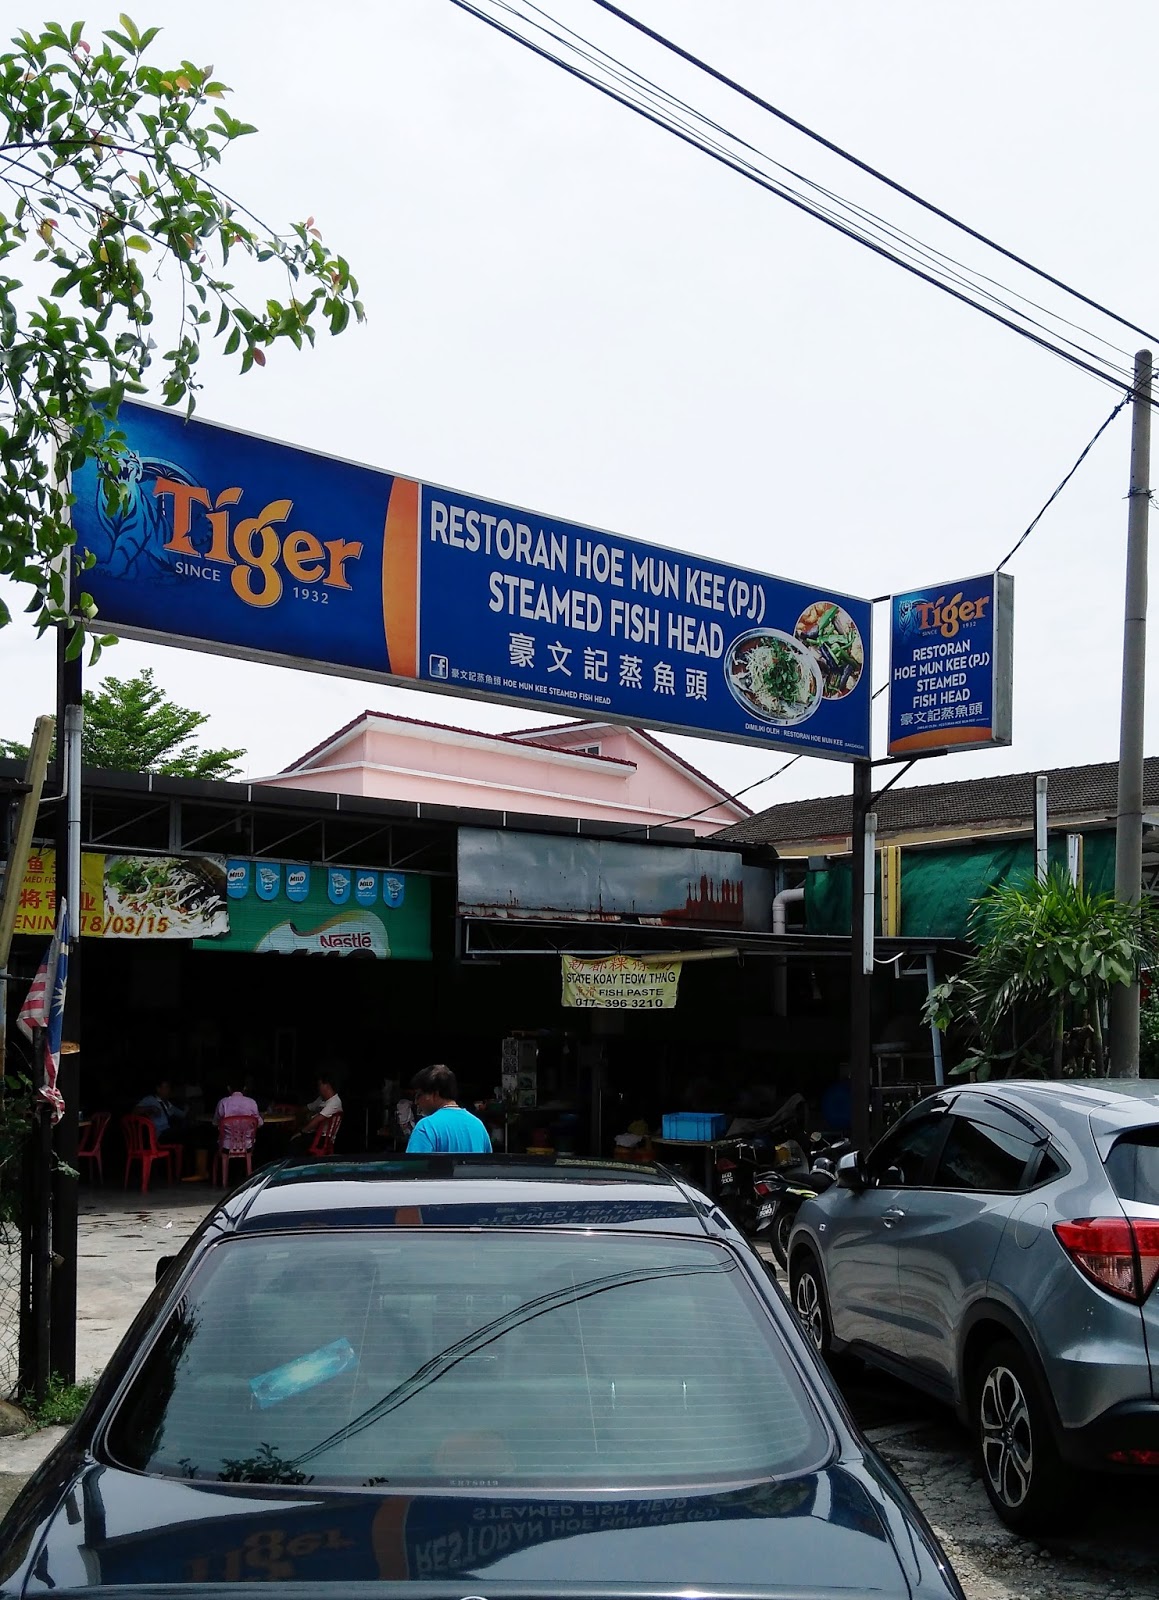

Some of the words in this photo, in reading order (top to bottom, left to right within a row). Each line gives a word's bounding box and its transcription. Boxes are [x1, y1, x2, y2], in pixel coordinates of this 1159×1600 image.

[153, 476, 363, 608] Tiger
[175, 561, 221, 582] SINCE
[430, 500, 567, 573] RESTORAN
[575, 538, 625, 588] HOE
[631, 553, 679, 600] MUN
[686, 567, 725, 612] KEE
[728, 577, 765, 624] (PJ)
[293, 587, 329, 604] 1932
[489, 571, 603, 632] STEAMED
[610, 599, 660, 646] FISH
[668, 612, 724, 659] HEAD
[916, 592, 990, 638] Tiger
[922, 629, 938, 637] SINCE
[913, 639, 970, 662] RESTORAN
[508, 632, 708, 702] 豪文記蒸魚頭
[894, 665, 916, 680] HOE
[919, 660, 943, 676] MUN
[945, 656, 966, 672] KEE
[968, 652, 990, 669] (PJ)
[451, 668, 502, 686] 豪文記蒸魚頭
[502, 679, 517, 689] HOE
[518, 682, 534, 692] MUN
[535, 684, 548, 694] KEE
[549, 687, 578, 699] STEAMED
[579, 692, 593, 702] FISH
[594, 695, 611, 705] HEAD
[917, 672, 967, 692] STEAMED
[913, 693, 937, 709] FISH
[940, 688, 971, 704] HEAD
[901, 702, 983, 726] 豪文記蒸魚頭
[783, 729, 811, 741] RESTORAN
[811, 735, 821, 743] HOE
[23, 876, 43, 884] MED
[14, 914, 56, 930] ENIN
[320, 932, 372, 948] Nestlé
[566, 973, 591, 984] STATE
[593, 973, 618, 984] KOAY
[620, 973, 646, 984] TEOW
[649, 972, 676, 984] THNG
[599, 989, 624, 997] FISH
[627, 988, 664, 997] PASTE
[605, 999, 627, 1008] 396
[631, 999, 663, 1008] 3210
